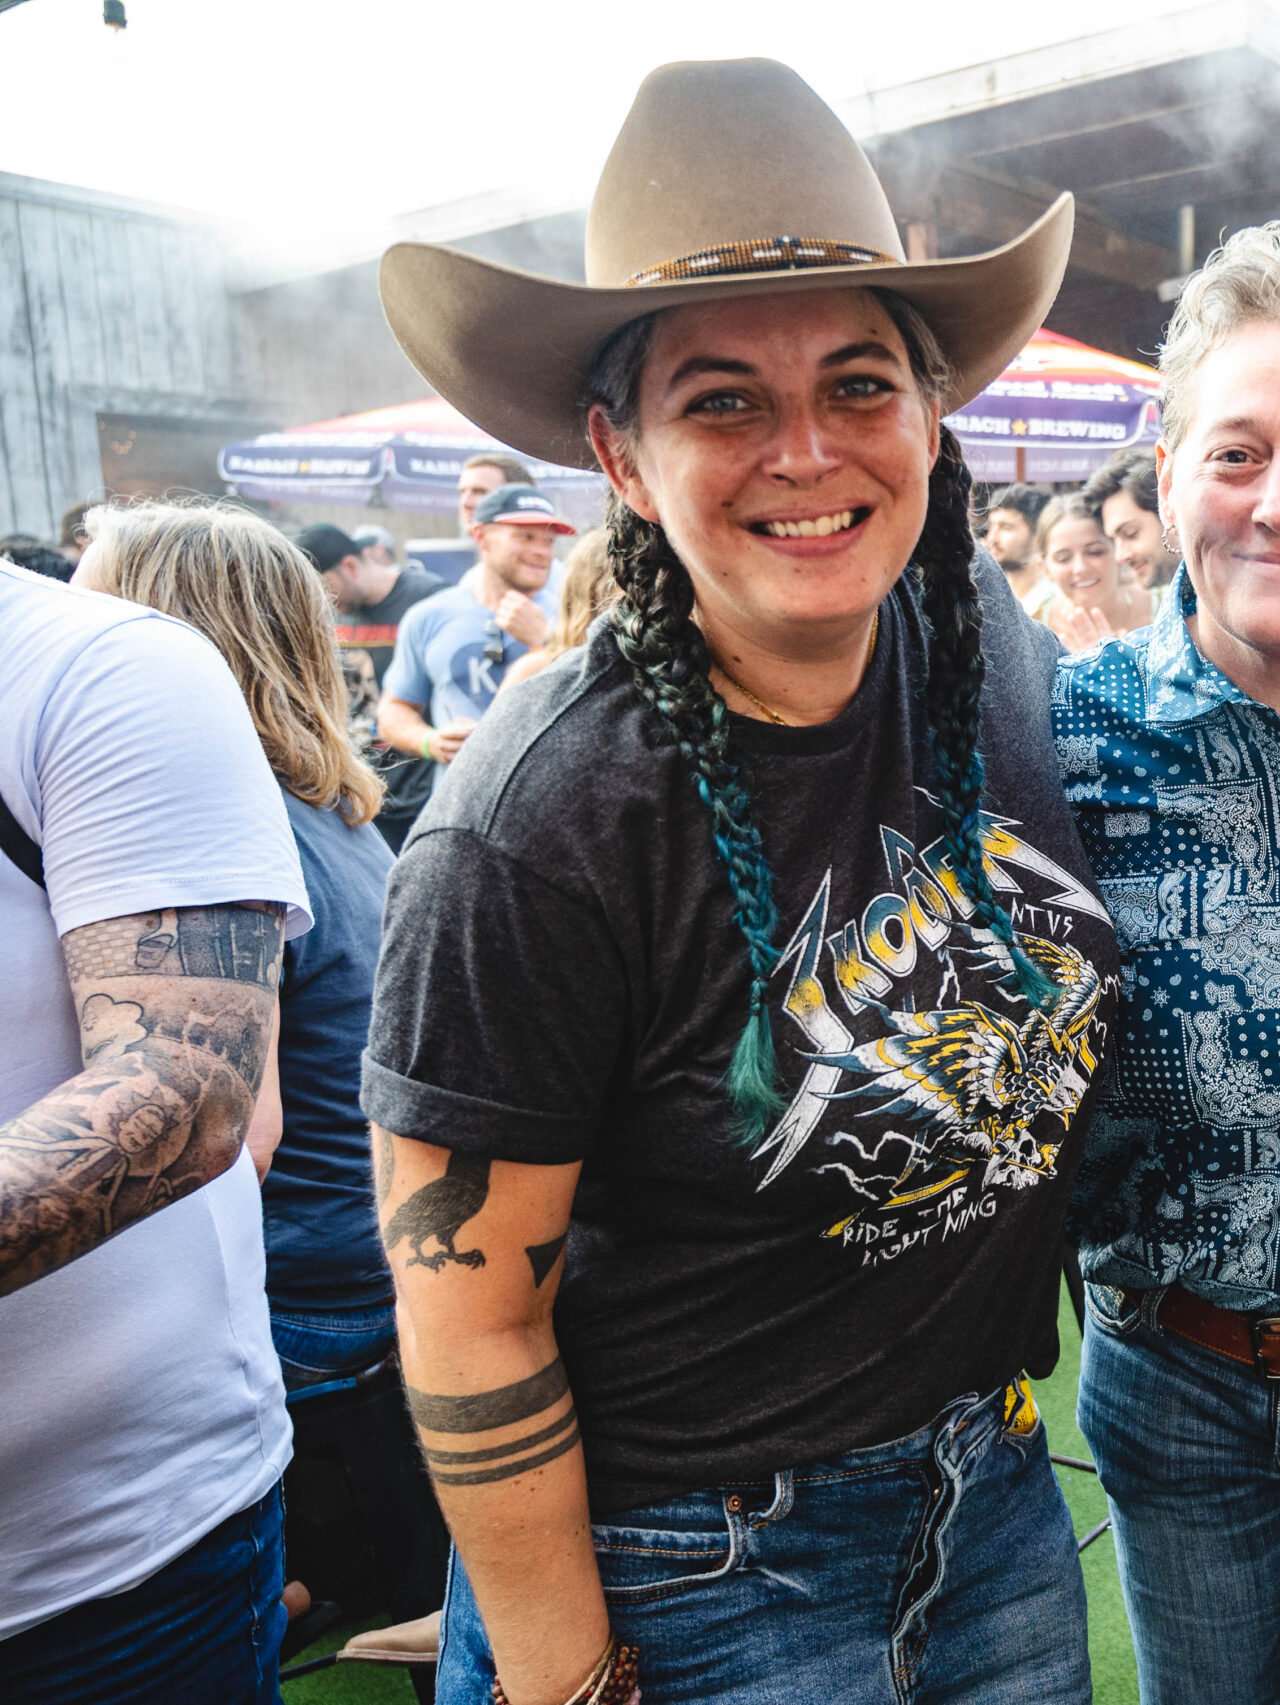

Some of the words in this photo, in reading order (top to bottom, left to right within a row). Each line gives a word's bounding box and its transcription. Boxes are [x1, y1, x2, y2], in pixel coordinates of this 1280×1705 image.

[1028, 418, 1127, 440] BREWING
[1010, 896, 1073, 939] NTVS
[918, 1186, 967, 1218] THE
